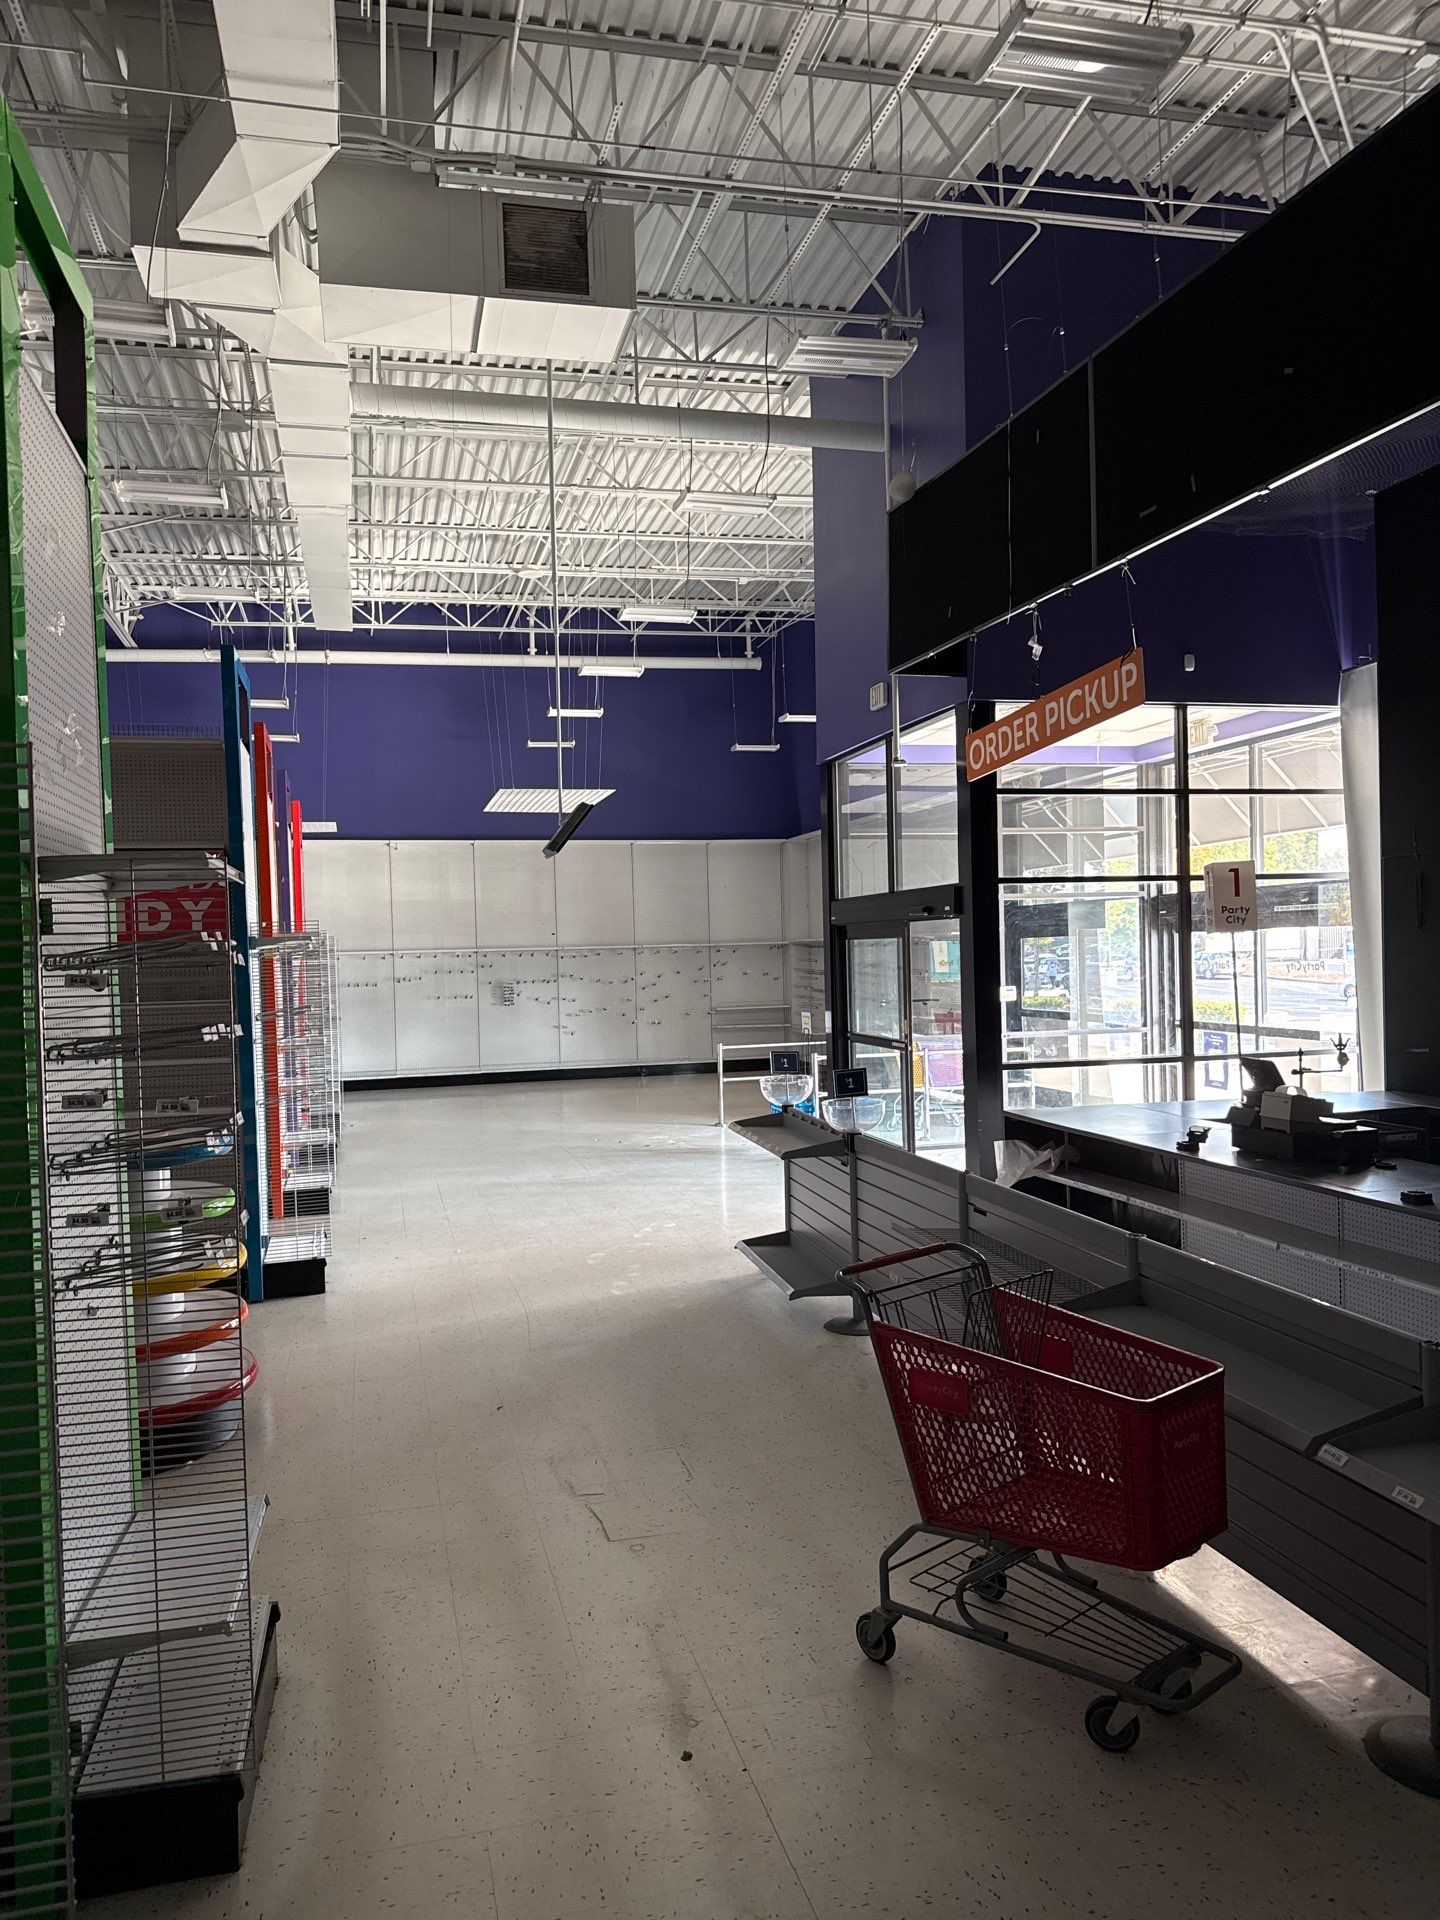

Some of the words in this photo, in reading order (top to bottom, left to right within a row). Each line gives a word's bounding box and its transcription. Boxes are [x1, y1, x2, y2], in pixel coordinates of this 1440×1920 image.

[969, 711, 1040, 771] ORDER
[1045, 662, 1138, 737] PICKUP
[1228, 867, 1241, 898] 1
[117, 898, 213, 932] DY
[1221, 905, 1251, 916] Party
[1225, 915, 1247, 926] City
